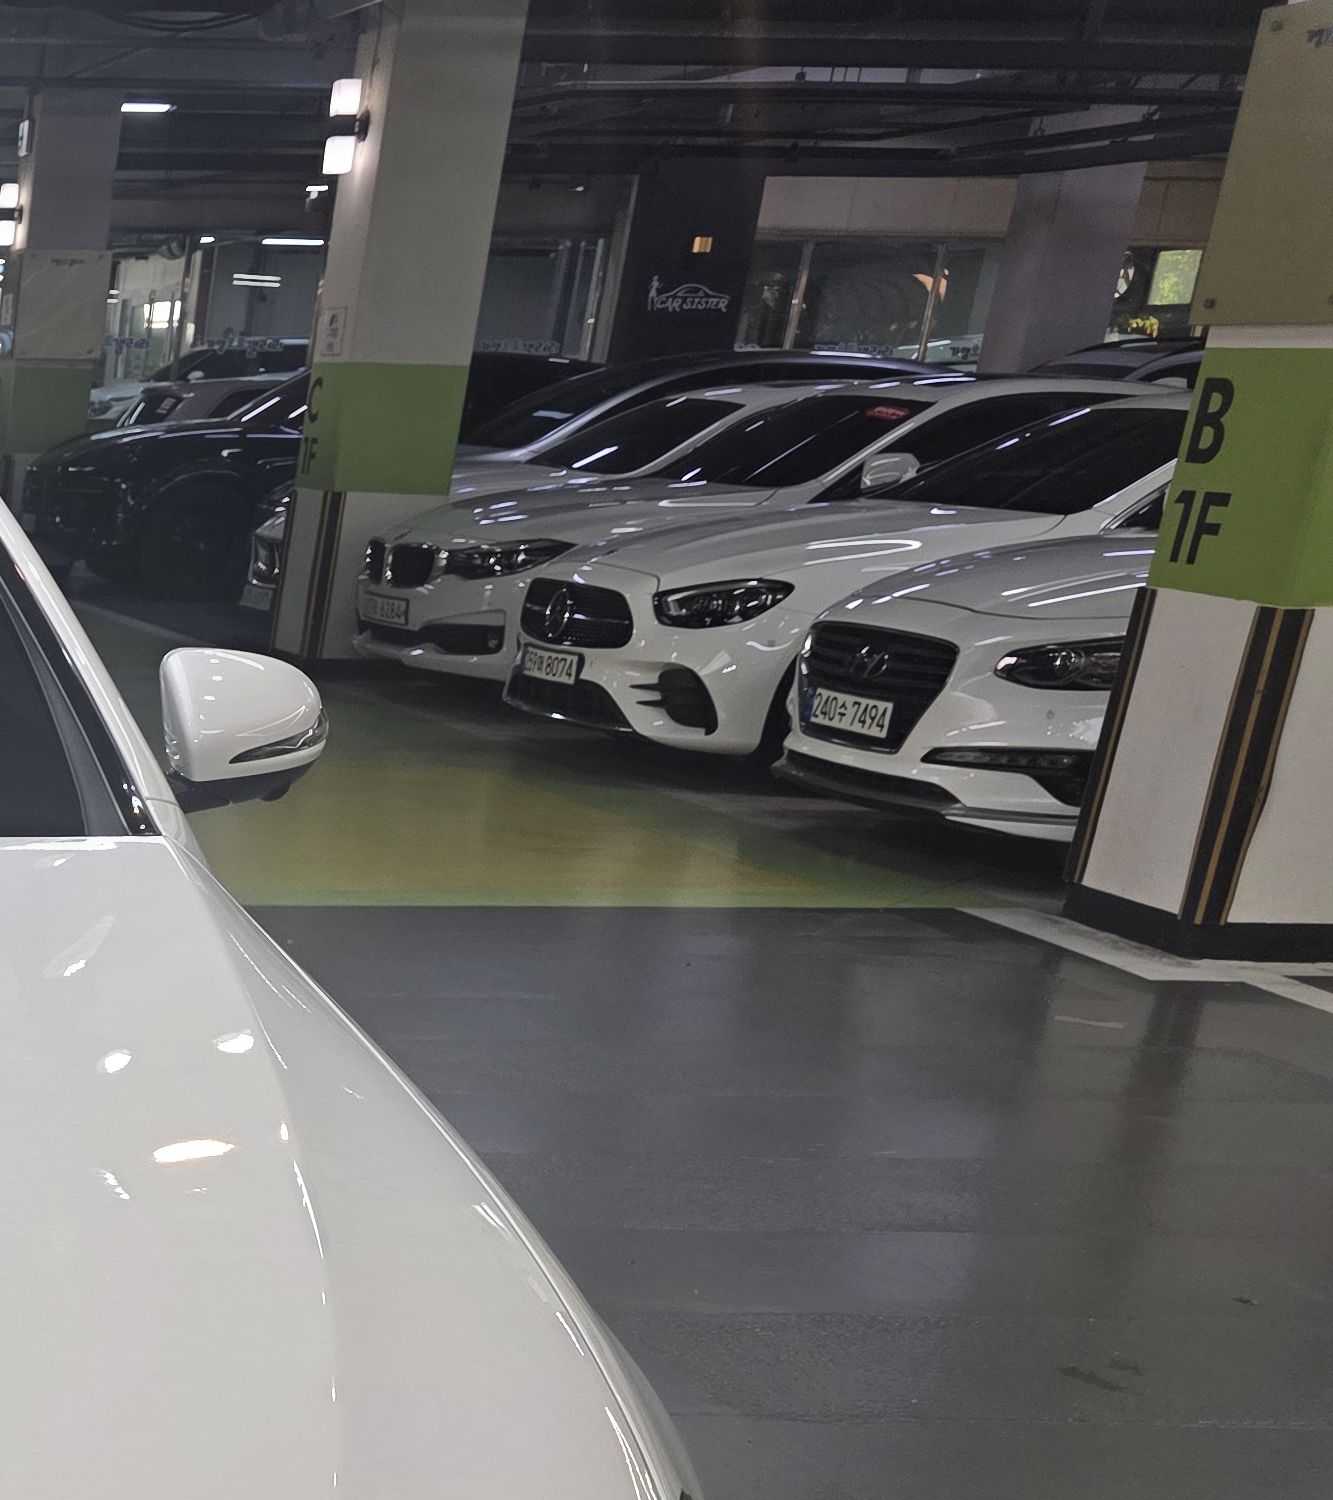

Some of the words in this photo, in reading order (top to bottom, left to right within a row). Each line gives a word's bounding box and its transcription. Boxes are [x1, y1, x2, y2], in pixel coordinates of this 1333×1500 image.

[655, 297, 680, 312] CAR
[682, 297, 729, 313] SISTER
[307, 375, 324, 423] C
[1184, 377, 1235, 465] B
[1169, 489, 1232, 566] 1F
[849, 700, 888, 733] 7494
